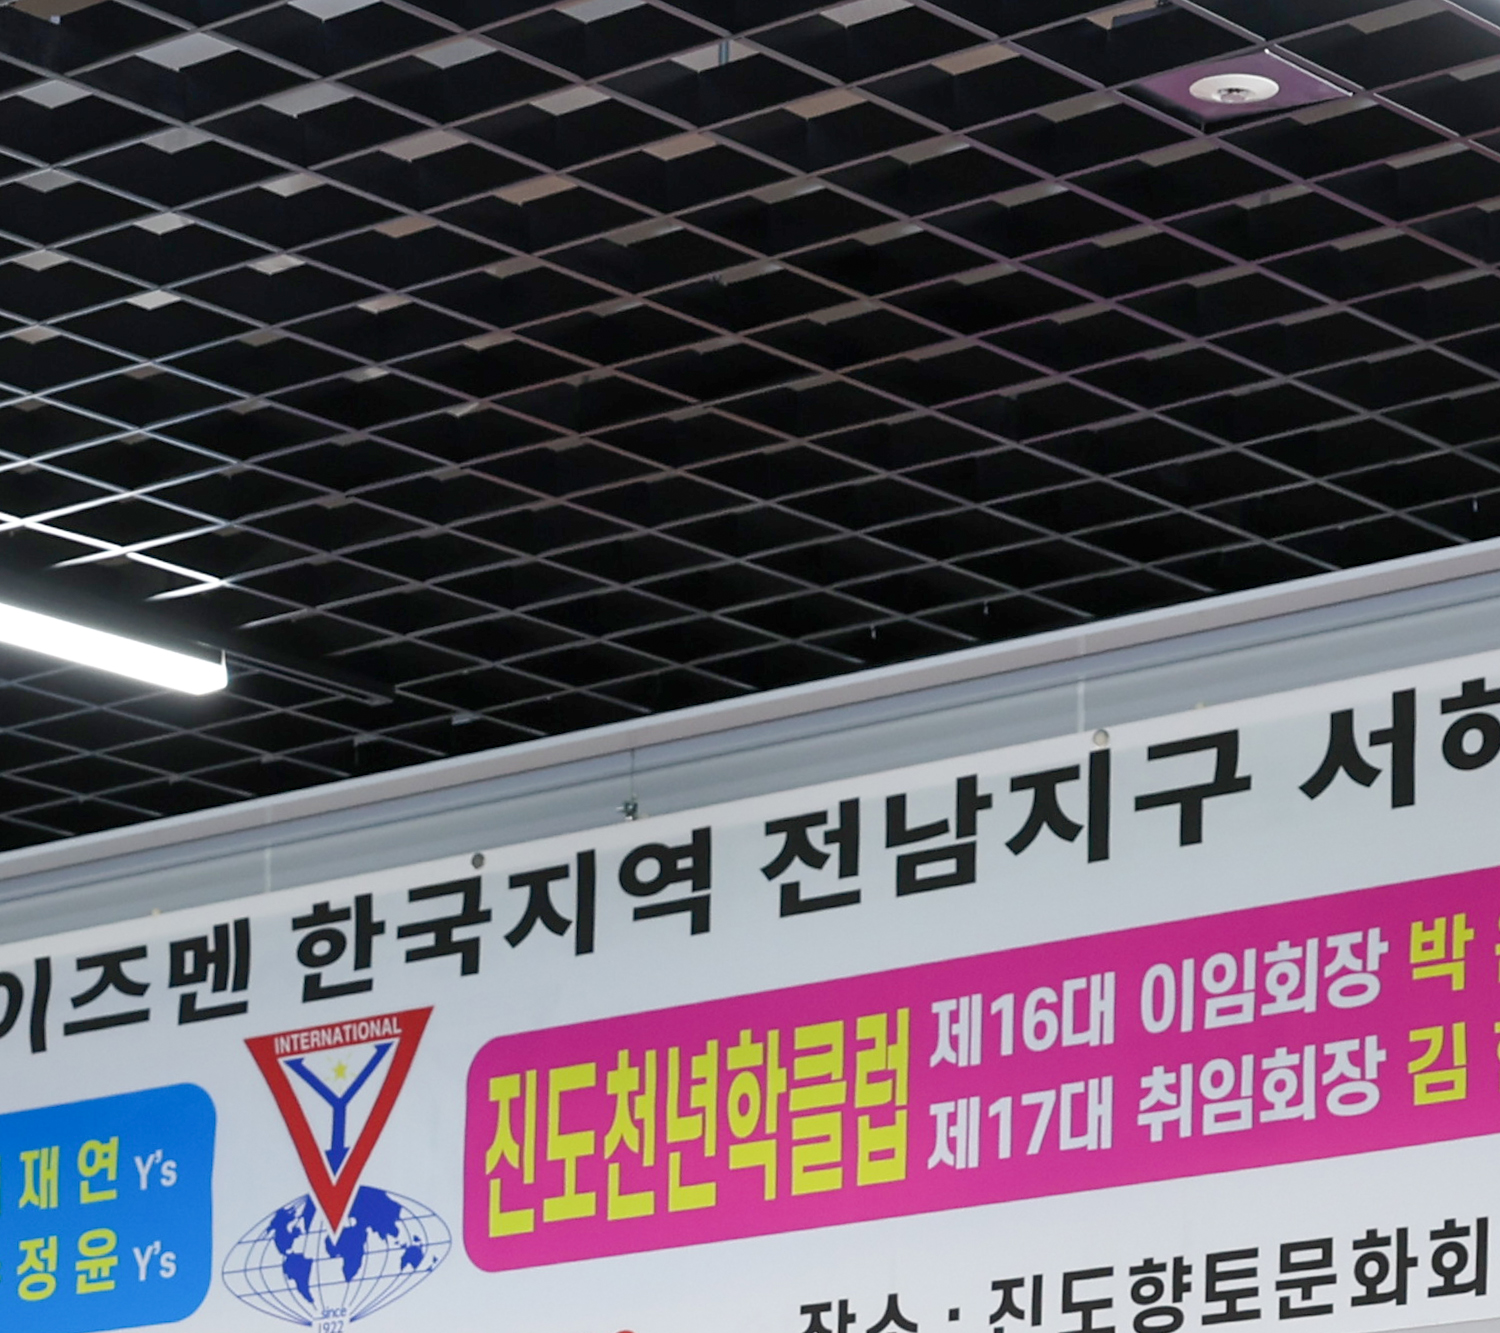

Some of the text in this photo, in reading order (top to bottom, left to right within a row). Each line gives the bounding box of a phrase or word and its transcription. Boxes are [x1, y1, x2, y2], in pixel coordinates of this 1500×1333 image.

[291, 826, 715, 1004] 한국지역
[760, 728, 1252, 919] 전남지구
[273, 1015, 403, 1055] INTERNATIONAL
[930, 972, 1115, 1067] 제16대
[1138, 929, 1389, 1034] 이임회장
[485, 1008, 909, 1238] 진도천년학클럽
[928, 1076, 1113, 1169] 제17대
[1137, 1035, 1386, 1142] 취임회장
